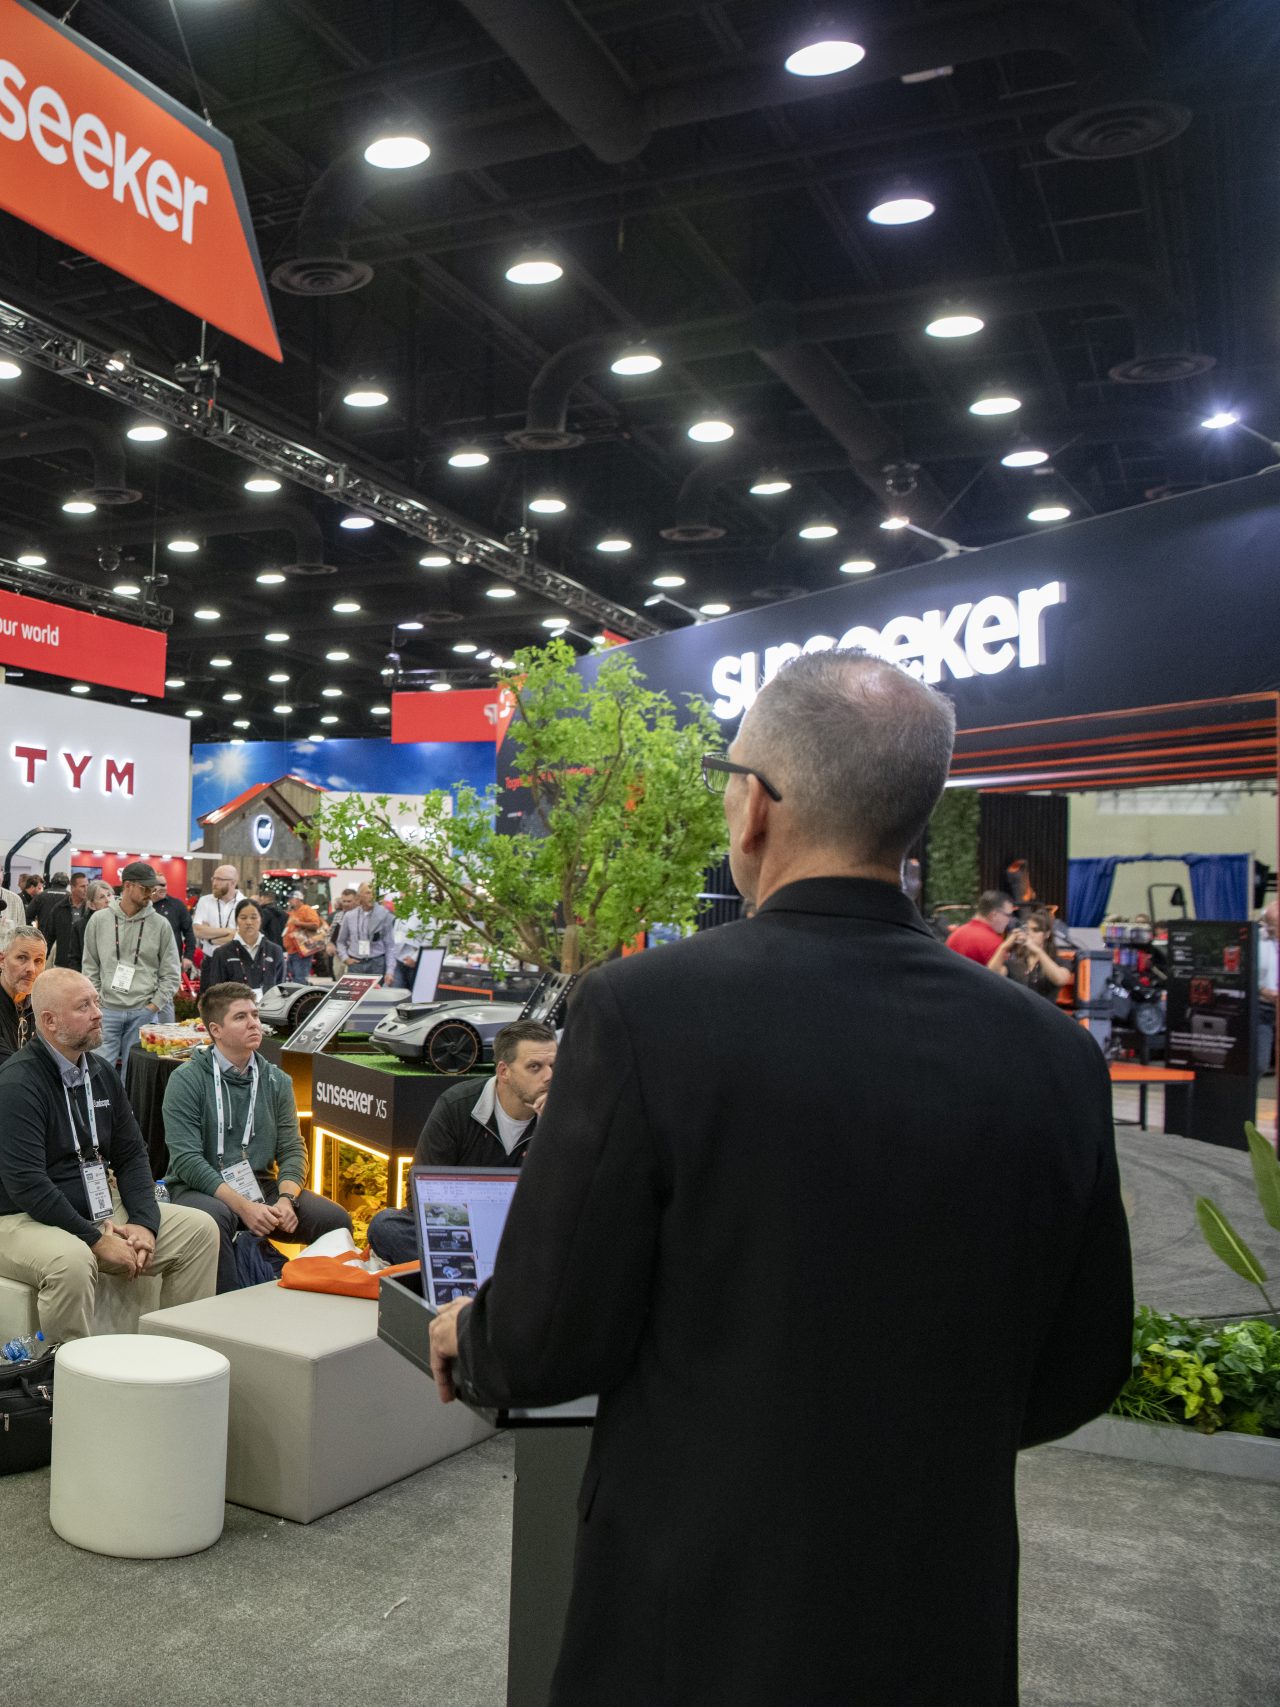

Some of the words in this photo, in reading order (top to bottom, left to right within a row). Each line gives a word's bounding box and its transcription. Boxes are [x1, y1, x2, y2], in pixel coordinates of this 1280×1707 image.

[21, 623, 60, 647] world
[15, 745, 135, 796] TYM
[316, 1081, 374, 1115] sunseeker
[375, 1098, 387, 1119] X5
